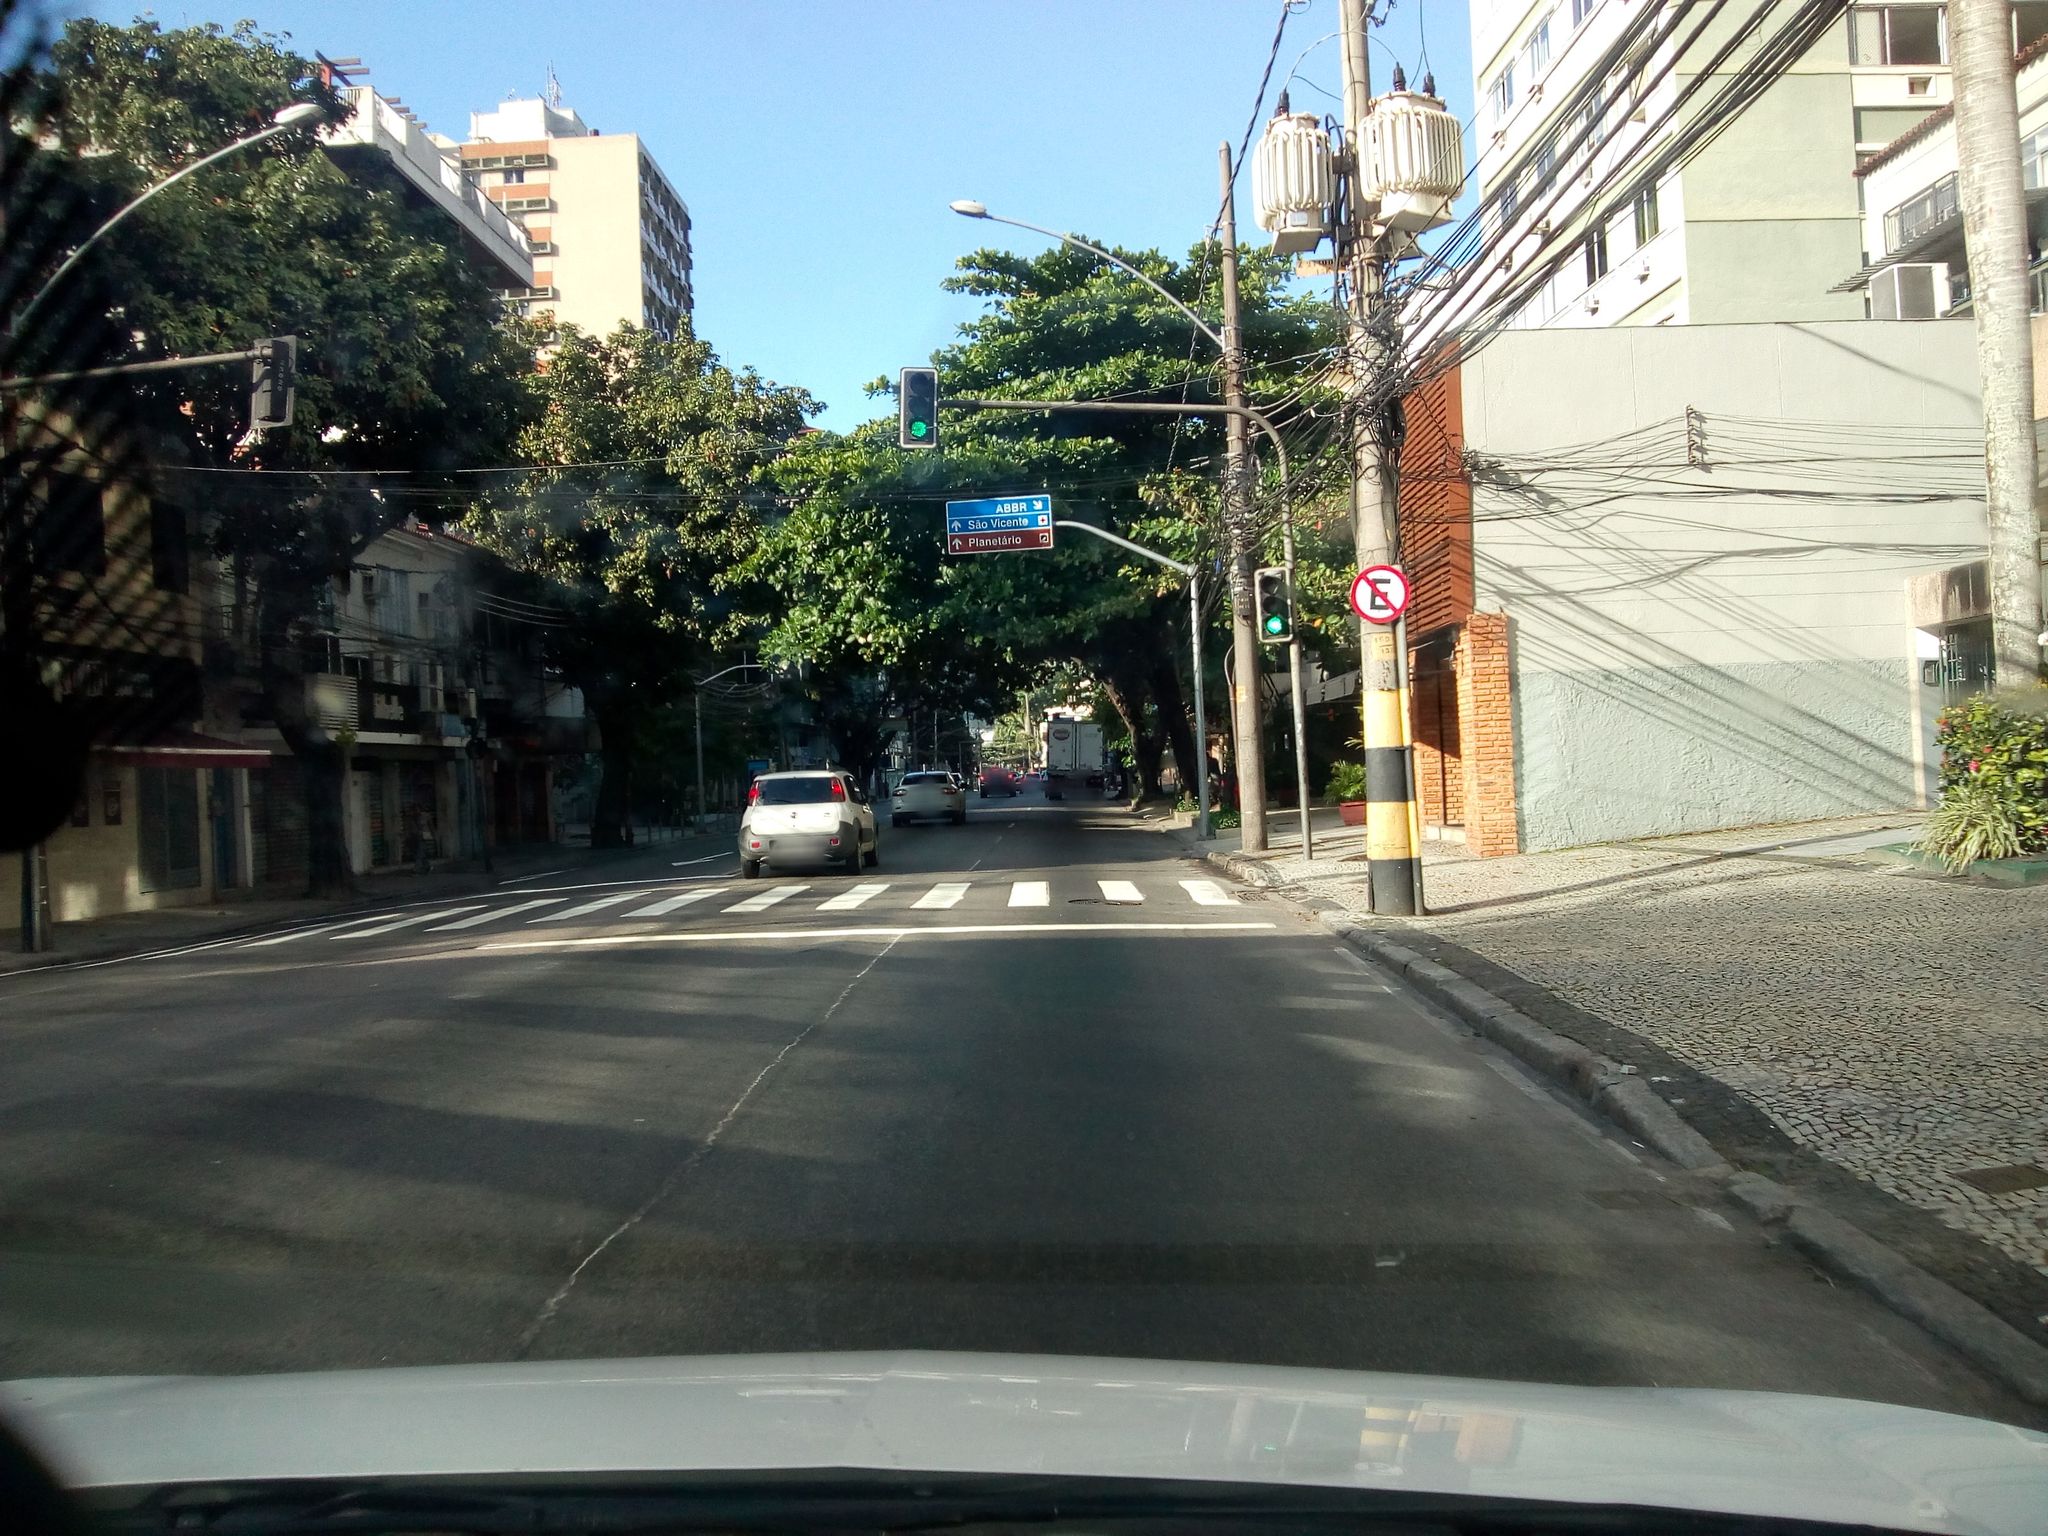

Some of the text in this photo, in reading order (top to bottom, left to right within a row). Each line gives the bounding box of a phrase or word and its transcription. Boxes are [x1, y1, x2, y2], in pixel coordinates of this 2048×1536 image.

[996, 502, 1028, 514] ABBR
[968, 517, 1029, 530] São Vicente
[968, 536, 1022, 548] Planetário
[1370, 578, 1391, 610] E
